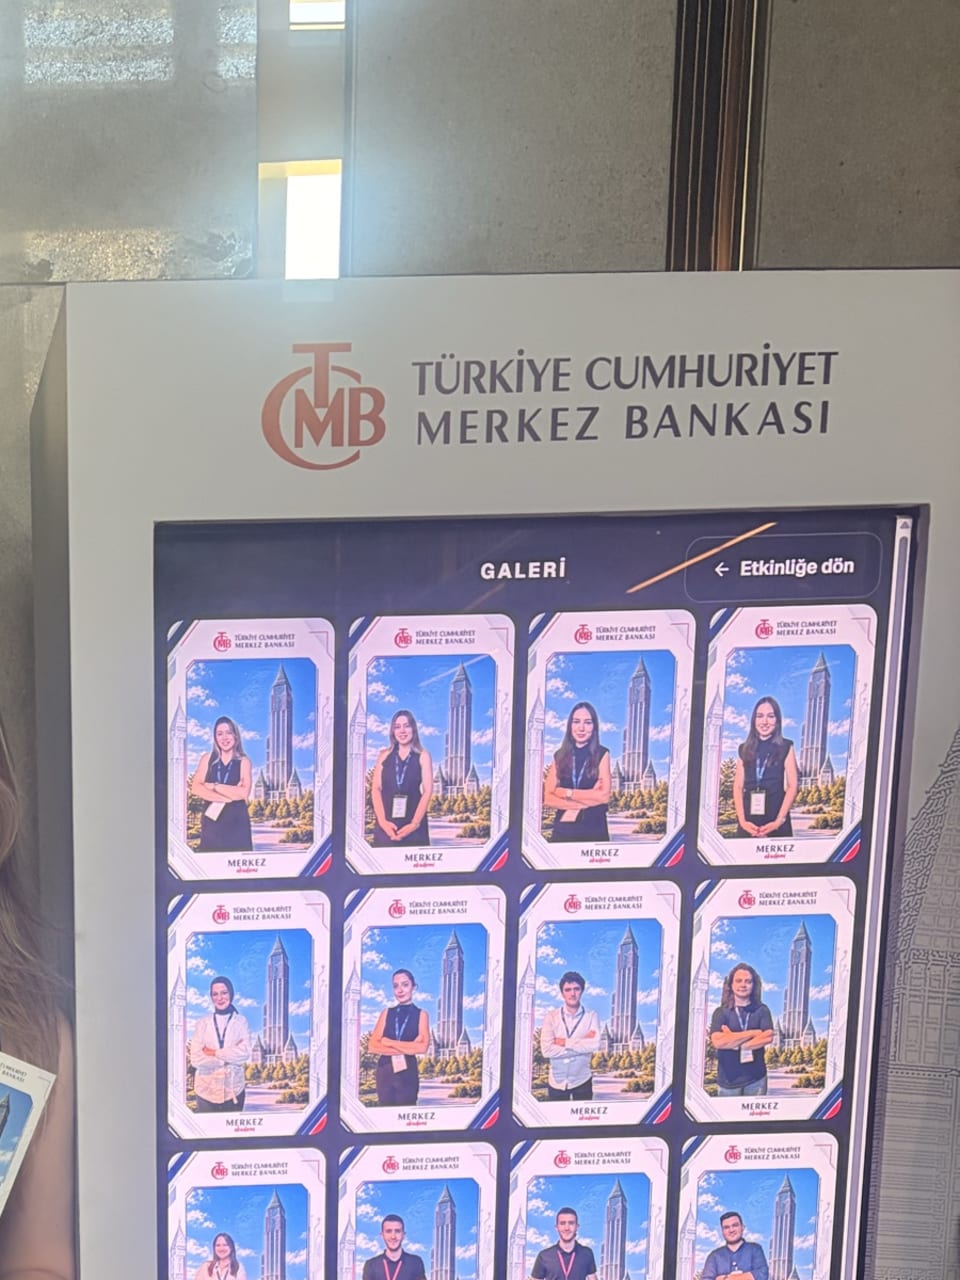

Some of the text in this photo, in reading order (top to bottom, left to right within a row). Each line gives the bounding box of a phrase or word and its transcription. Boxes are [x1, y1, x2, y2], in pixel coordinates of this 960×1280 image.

[412, 342, 839, 396] TÜRKİYE CUMHURİYET
[417, 400, 830, 446] MERKEZ BANKASI
[480, 557, 567, 580] GALERİ
[740, 557, 855, 579] Etkinliğe dön
[580, 848, 619, 857] MERKEZ
[755, 844, 795, 853] MERKEZ
[404, 852, 443, 862] MERKEZ
[227, 858, 266, 867] MERKEZ
[570, 1106, 608, 1115] MERKEZ
[741, 1101, 779, 1111] MERKEZ
[397, 1112, 436, 1121] MERKEZ
[225, 1117, 264, 1127] MERKEZ
